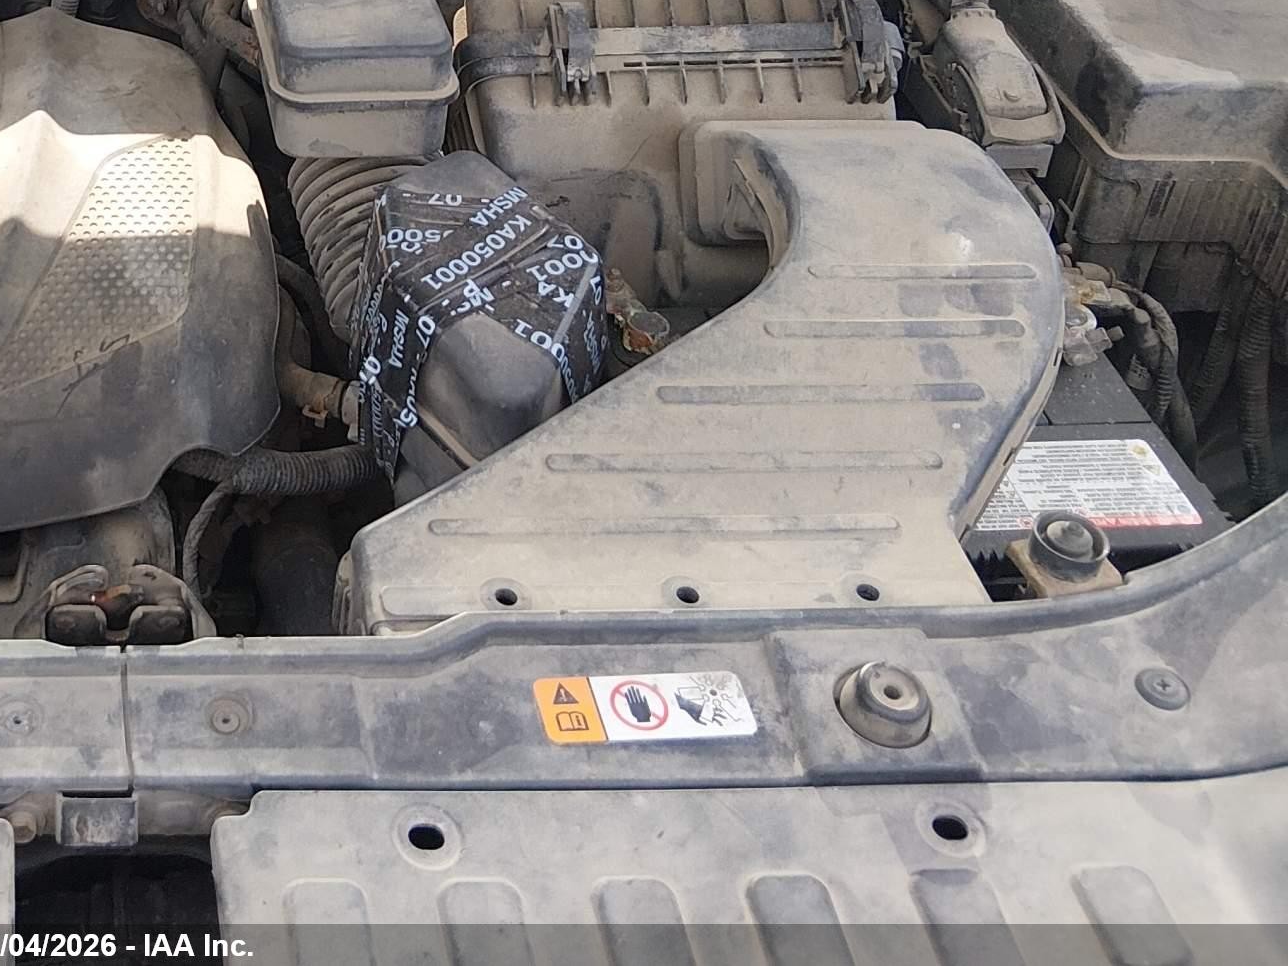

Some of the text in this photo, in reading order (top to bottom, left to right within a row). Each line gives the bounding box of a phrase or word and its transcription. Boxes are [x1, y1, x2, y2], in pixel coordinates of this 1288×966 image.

[470, 187, 528, 228] MSHA
[420, 213, 533, 290] KA050001
[387, 308, 410, 369] MSHA
